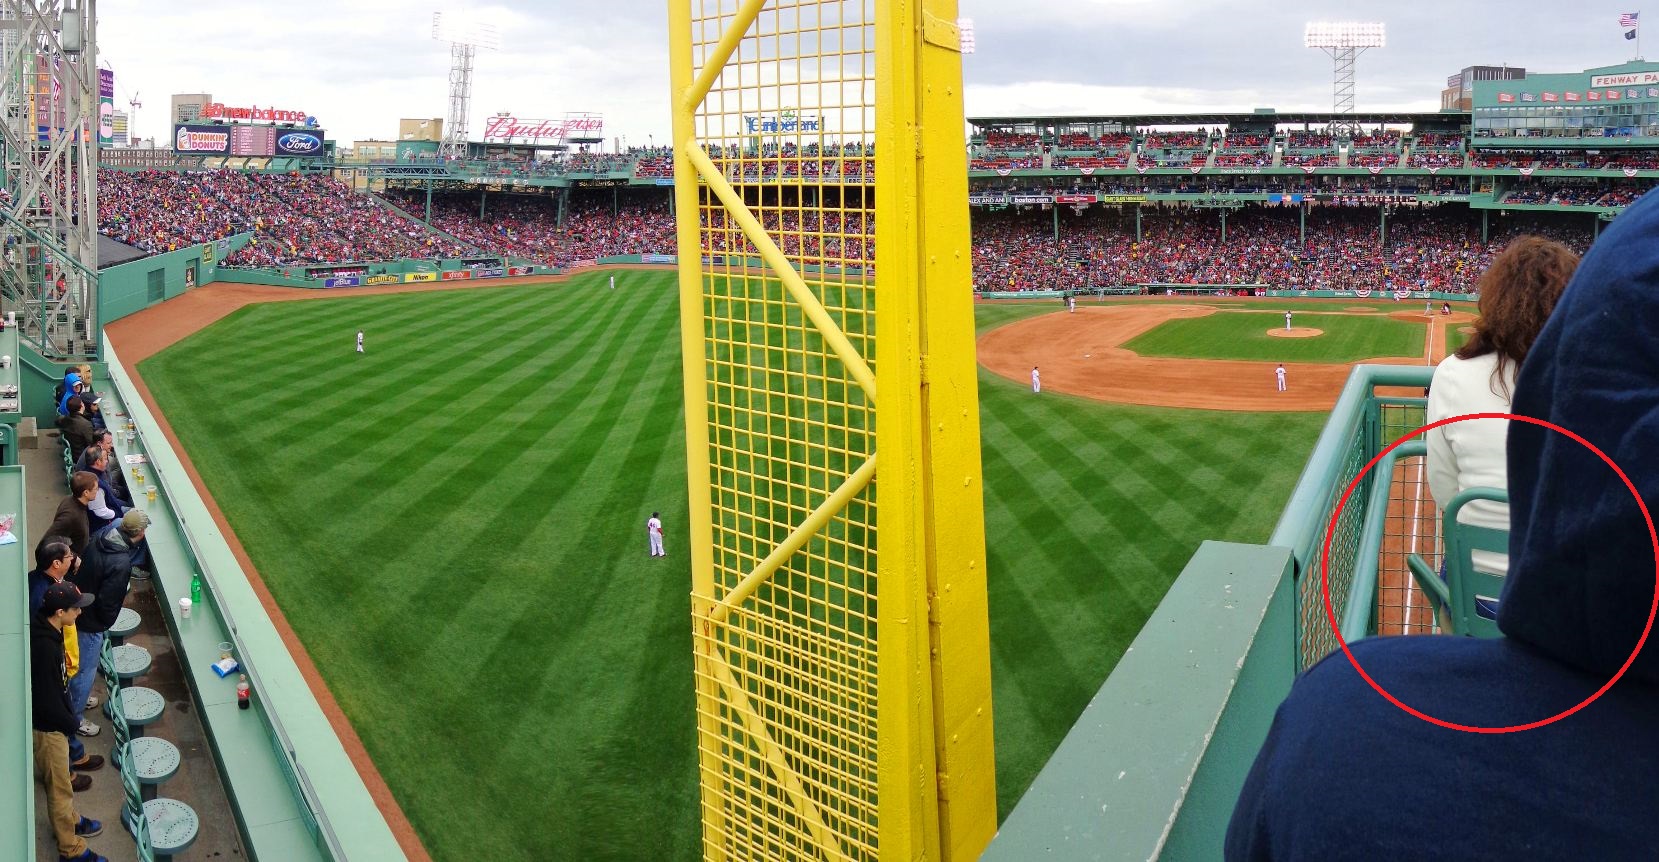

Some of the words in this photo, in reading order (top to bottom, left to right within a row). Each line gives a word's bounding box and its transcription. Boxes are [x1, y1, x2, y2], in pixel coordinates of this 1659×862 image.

[1596, 75, 1638, 85] FENWAY
[223, 105, 252, 119] new
[252, 104, 306, 122] balance
[191, 133, 227, 142] DUNKIN'
[191, 141, 225, 150] DONUTS
[286, 135, 313, 151] Ford
[448, 271, 465, 279] xfinity
[333, 278, 351, 287] jetBlue
